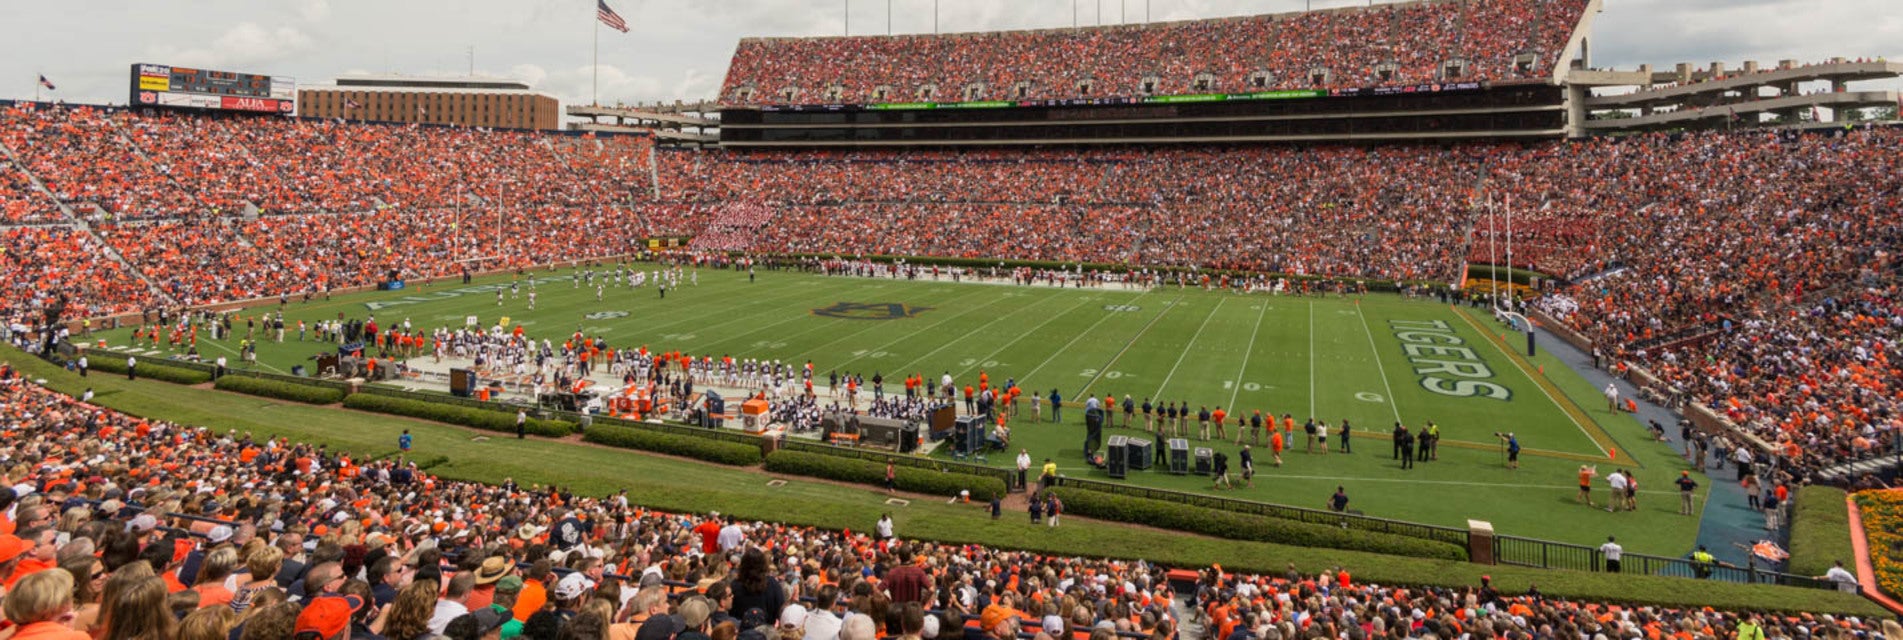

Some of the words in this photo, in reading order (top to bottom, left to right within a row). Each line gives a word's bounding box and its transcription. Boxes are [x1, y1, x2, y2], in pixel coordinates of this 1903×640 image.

[959, 358, 999, 368] 30
[1387, 319, 1513, 401] TIGERS
[1079, 368, 1123, 379] 20
[1223, 381, 1261, 391] 10
